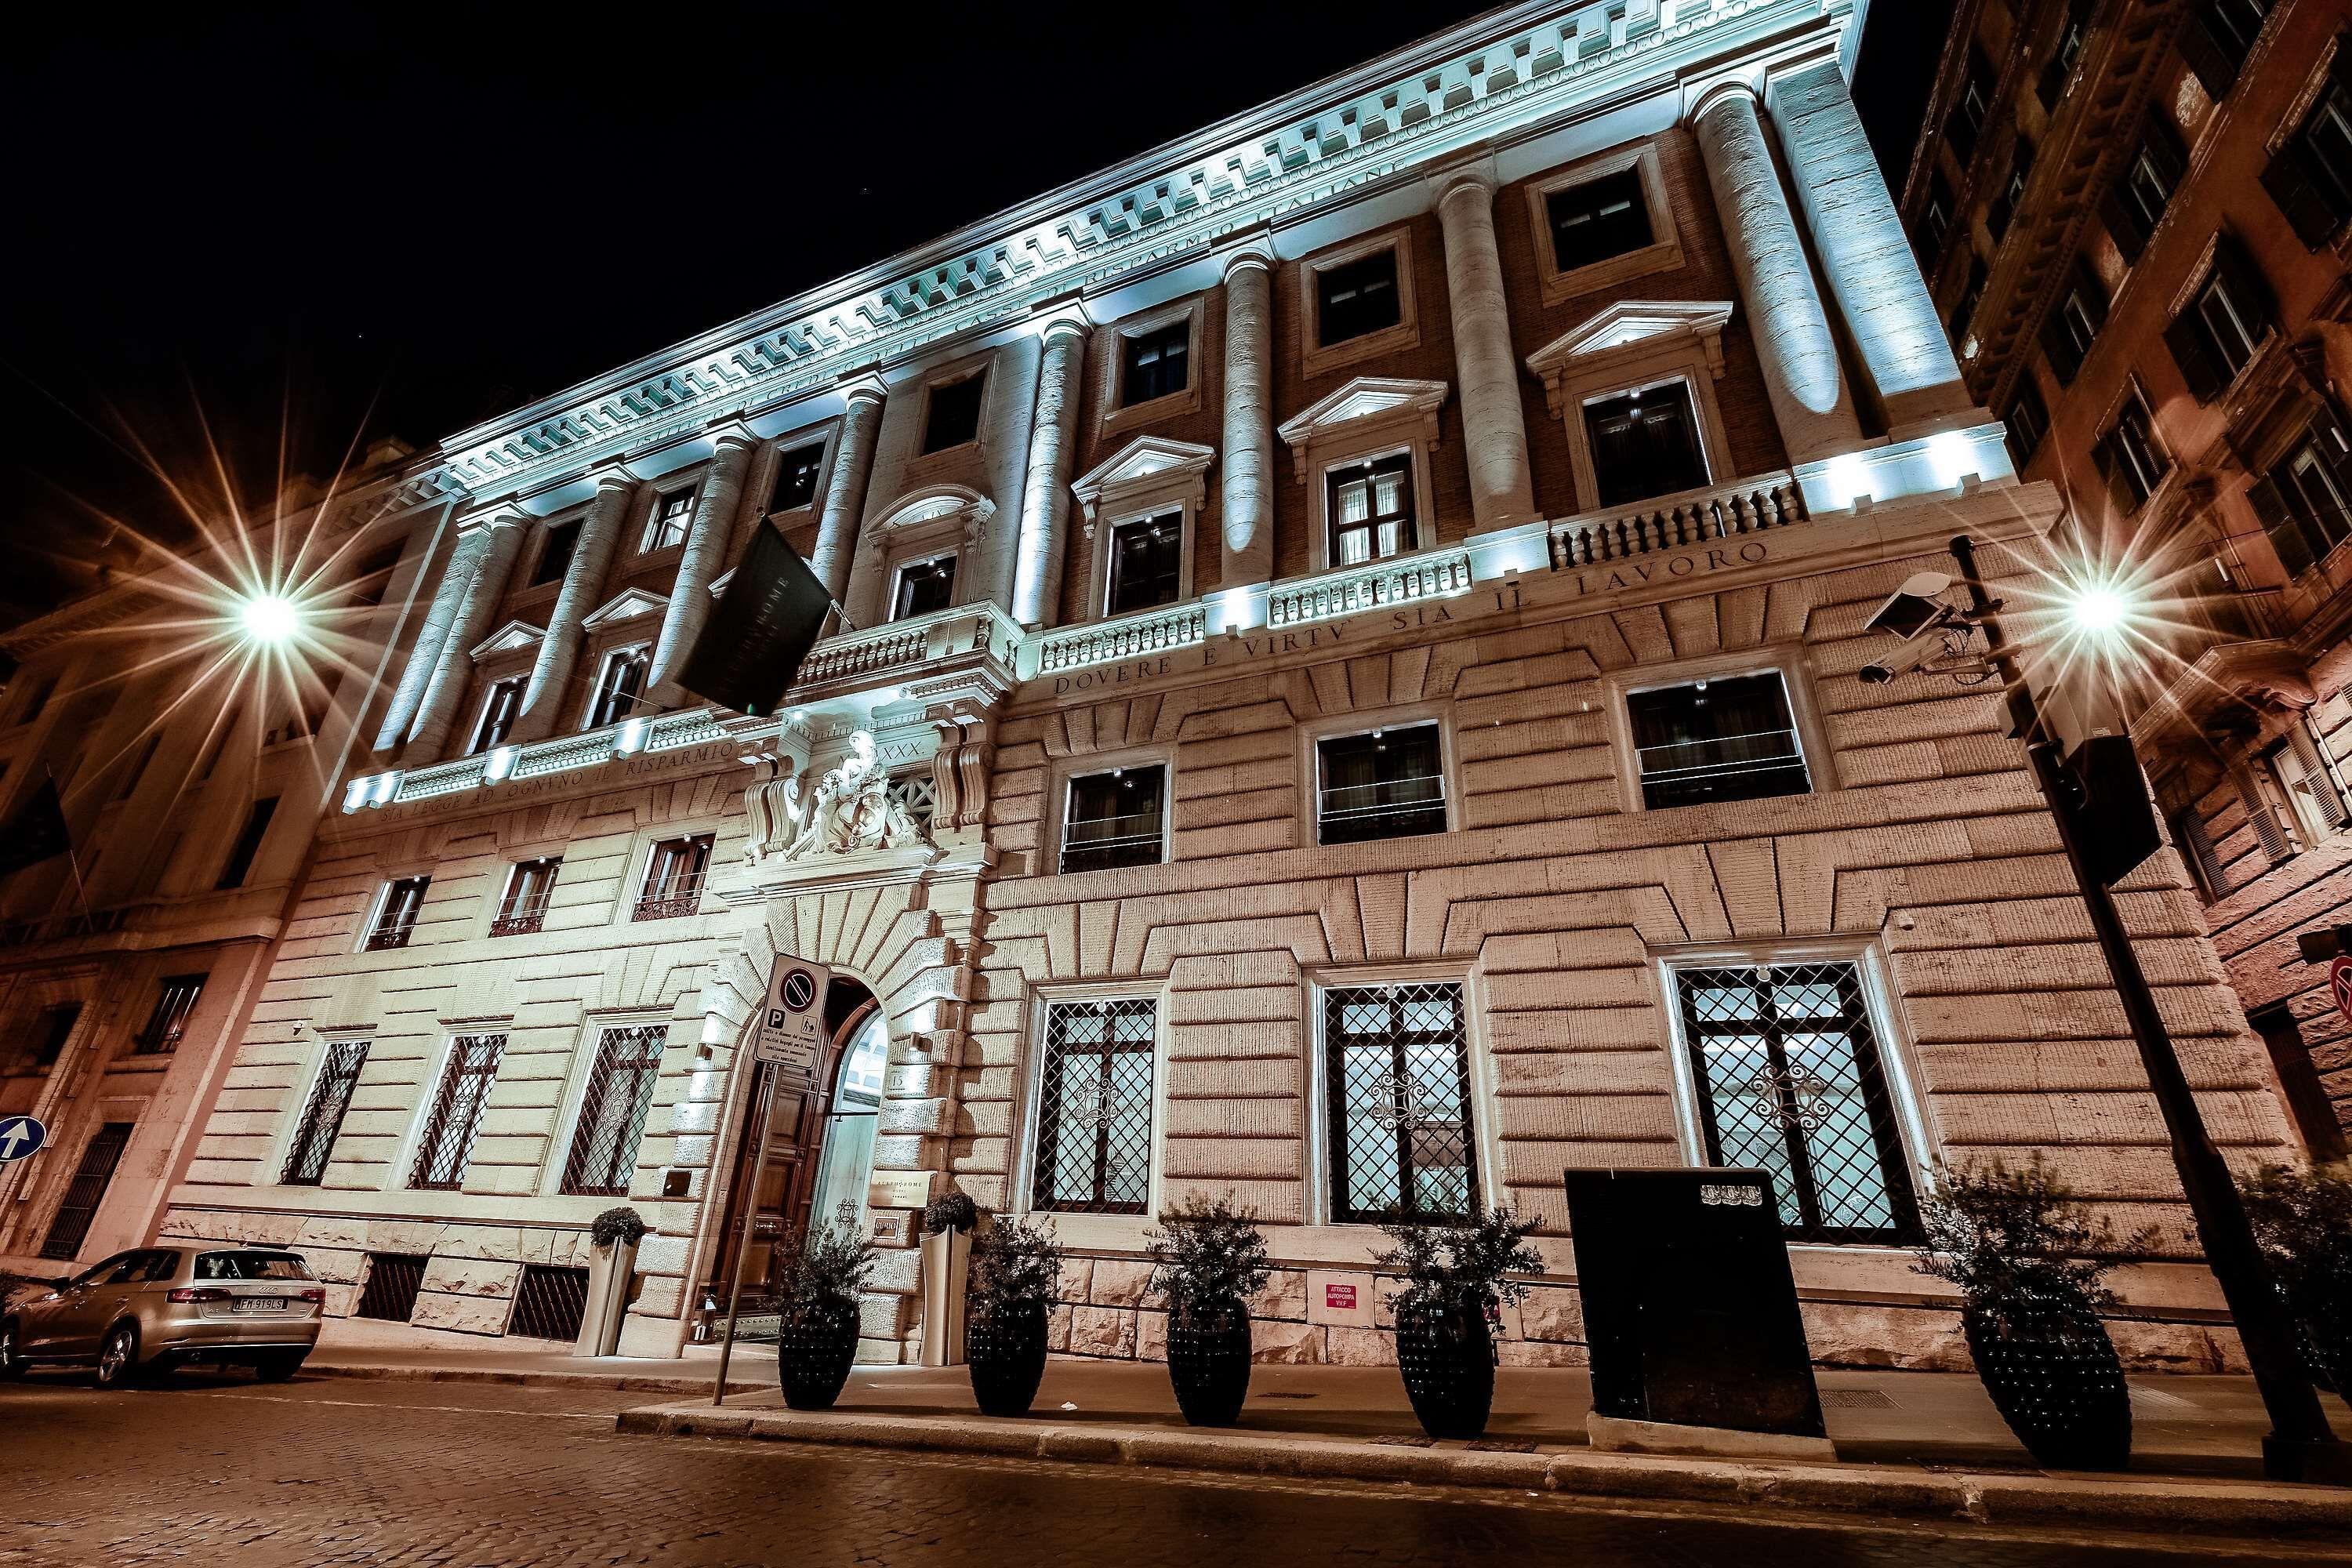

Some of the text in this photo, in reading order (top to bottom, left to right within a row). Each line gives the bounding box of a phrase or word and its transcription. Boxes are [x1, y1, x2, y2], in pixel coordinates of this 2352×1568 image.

[1084, 223, 1234, 285] RISPARMIO
[1053, 657, 1171, 695] DOVERE
[1203, 648, 1218, 666] E
[1393, 604, 1454, 630] SIA
[1494, 589, 1531, 611] IL
[1576, 543, 1767, 596] LAVORO
[412, 795, 465, 816] LEGGE
[471, 789, 494, 804] AD
[626, 742, 733, 775] RISPARMIO
[771, 1011, 782, 1025] P
[892, 1075, 902, 1087] 15
